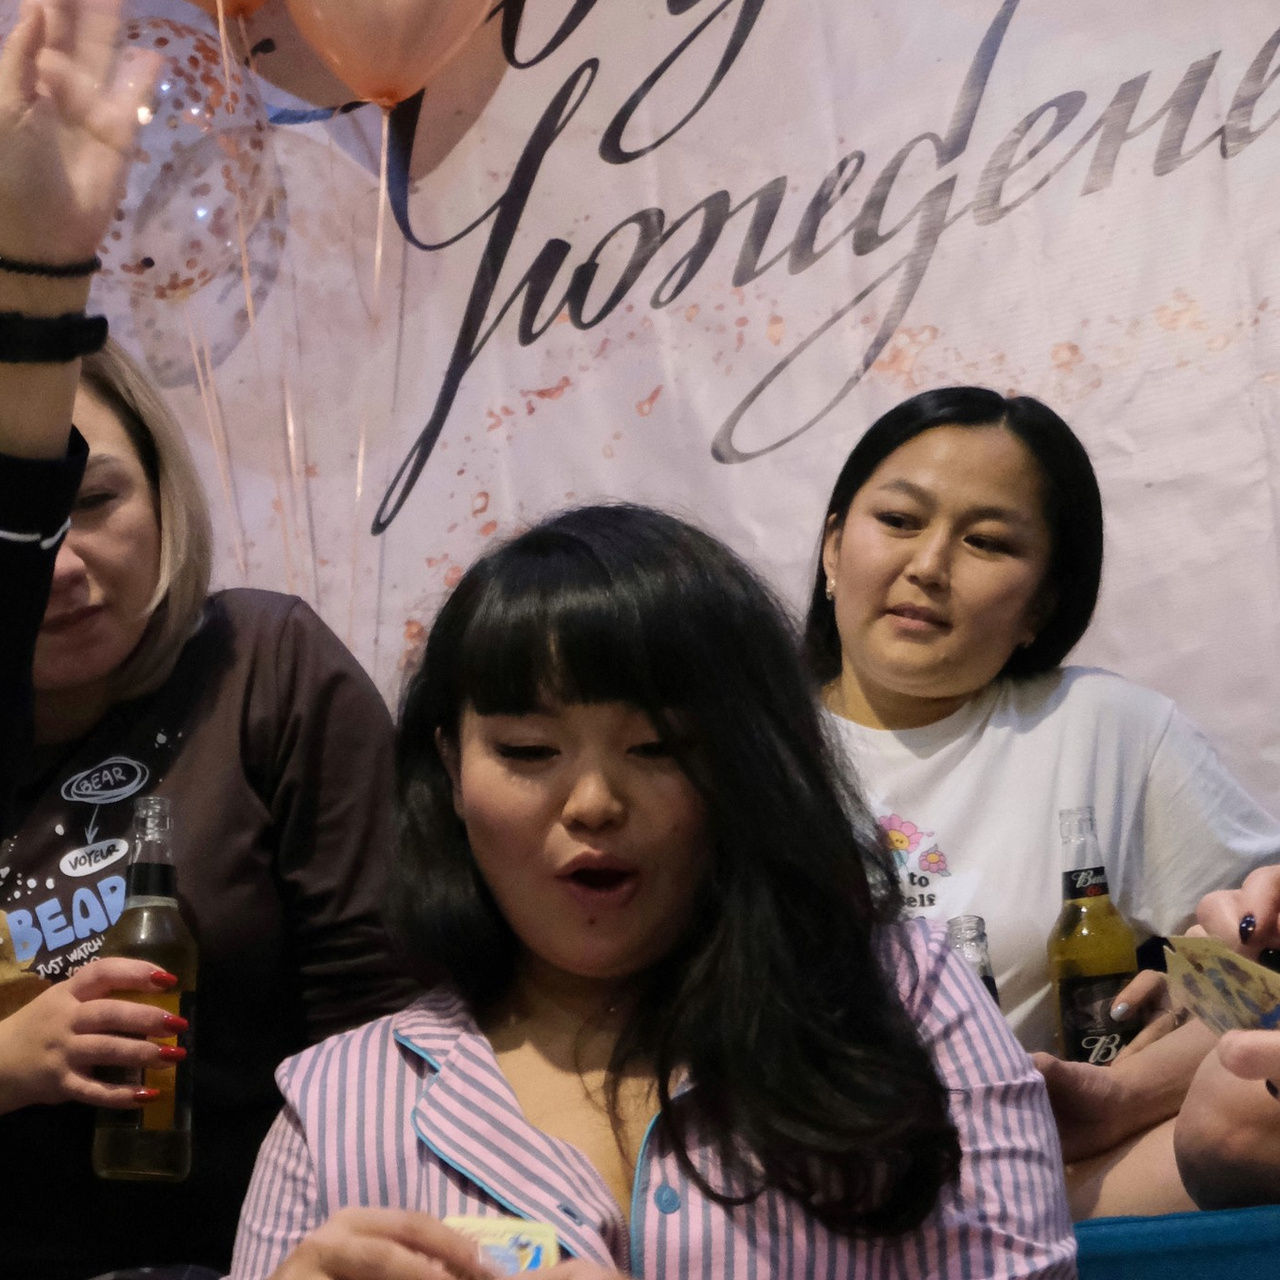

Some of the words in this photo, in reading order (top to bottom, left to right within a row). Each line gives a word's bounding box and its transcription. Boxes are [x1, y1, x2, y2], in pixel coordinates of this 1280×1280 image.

[80, 767, 127, 793] BEAR
[68, 843, 120, 871] VOYEUR
[907, 871, 930, 888] to
[36, 956, 64, 980] JUST
